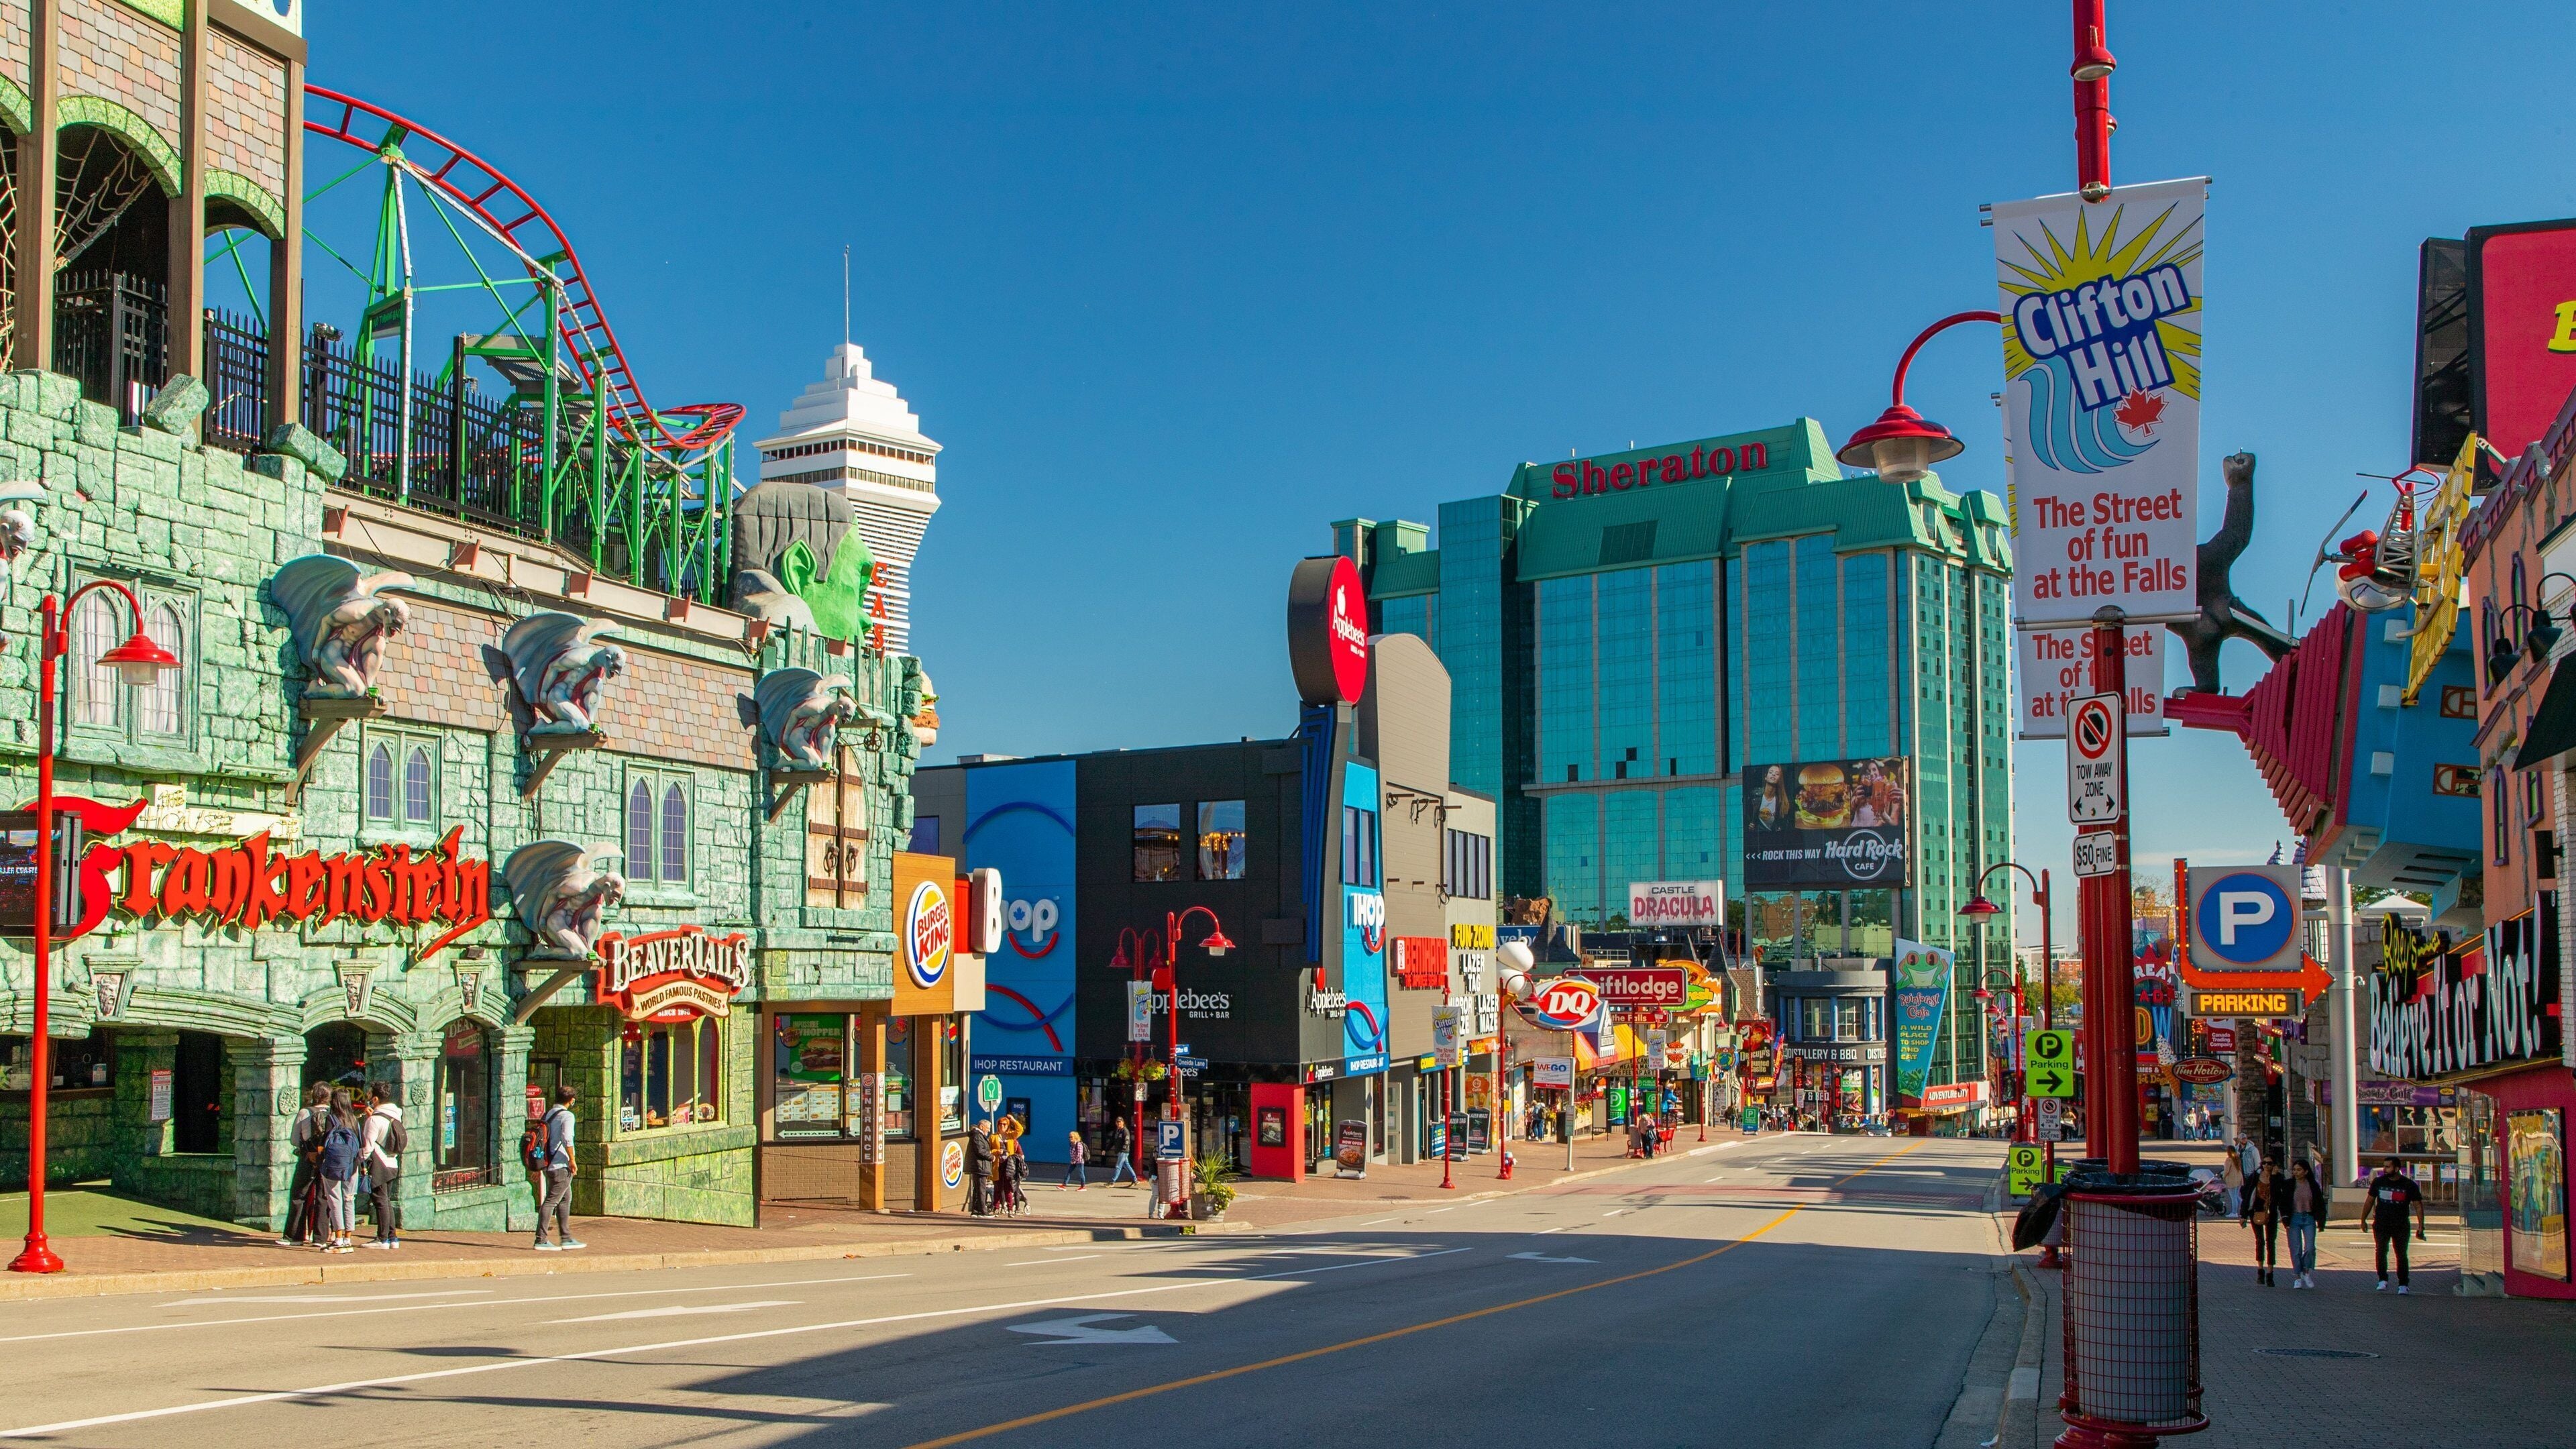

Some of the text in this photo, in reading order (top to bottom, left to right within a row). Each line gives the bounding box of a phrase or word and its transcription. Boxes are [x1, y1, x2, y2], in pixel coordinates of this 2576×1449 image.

[2015, 265, 2147, 358] Clifton
[2070, 330, 2169, 407] Hill
[1552, 442, 1768, 498] Sheraton
[2033, 488, 2183, 529] The Street
[2068, 527, 2149, 561] of fun
[2033, 558, 2187, 599] at the Falls
[1332, 604, 1365, 647] Applebee's
[2033, 631, 2153, 660] The Set
[2059, 660, 2083, 688] of
[2031, 692, 2055, 718] at
[2076, 762, 2112, 780] TOW AWAY
[2085, 781, 2104, 797] ZONE
[1762, 849, 1821, 861] ROCK THIS WAY
[1825, 839, 1903, 860] Hard Rock
[2076, 844, 2112, 866] $50 FINE
[1855, 863, 1874, 871] CAFE
[1651, 886, 1695, 894] CASTLE
[1633, 895, 1715, 922] DRACULA
[917, 902, 947, 938] BURGER
[2220, 892, 2275, 945] P
[918, 918, 949, 964] KING
[1454, 924, 1495, 948] FUN ZONE
[1462, 954, 1485, 973] LAZER
[1467, 973, 1481, 993] TAG
[1599, 975, 1678, 1000] iftlodge
[2434, 891, 2541, 1074] It or Not!
[641, 985, 722, 1011] WORLD FAMOUS PASTRIES
[1311, 983, 1346, 1014] Applebee's
[1478, 994, 1499, 1013] LAZER
[1547, 991, 1591, 1017] DQ
[1898, 992, 1940, 1007] Rainforest
[2200, 994, 2287, 1012] PARKING
[657, 1009, 676, 1017] SINCE
[1189, 1011, 1208, 1019] GRILL
[1216, 1011, 1230, 1019] BAR
[1434, 1017, 1457, 1028] Clifton
[1907, 1006, 1929, 1020] Cafe
[1441, 1026, 1454, 1037] Hill
[1480, 1012, 1498, 1034] MAZE
[2369, 972, 2431, 1079] Believe
[1787, 1049, 1829, 1061] DISTILLERY
[1839, 1049, 1858, 1060] BBQ
[2042, 1037, 2058, 1055] P
[974, 1059, 1063, 1071] IHOP RESTAURANT
[1360, 1057, 1384, 1070] RESTAURNT
[1537, 1064, 1567, 1072] WEGO
[2031, 1061, 2068, 1070] Parking
[2176, 1064, 2229, 1075] Tim Hortons
[2138, 1075, 2147, 1083] Hot
[1927, 1089, 1957, 1101] ADVENTURE
[622, 1110, 633, 1120] OPEN
[1163, 1125, 1179, 1146] P
[945, 1150, 961, 1167] BURGER
[945, 1158, 962, 1177] KING
[2021, 1152, 2033, 1165] P
[2011, 1167, 2040, 1177] Parking
